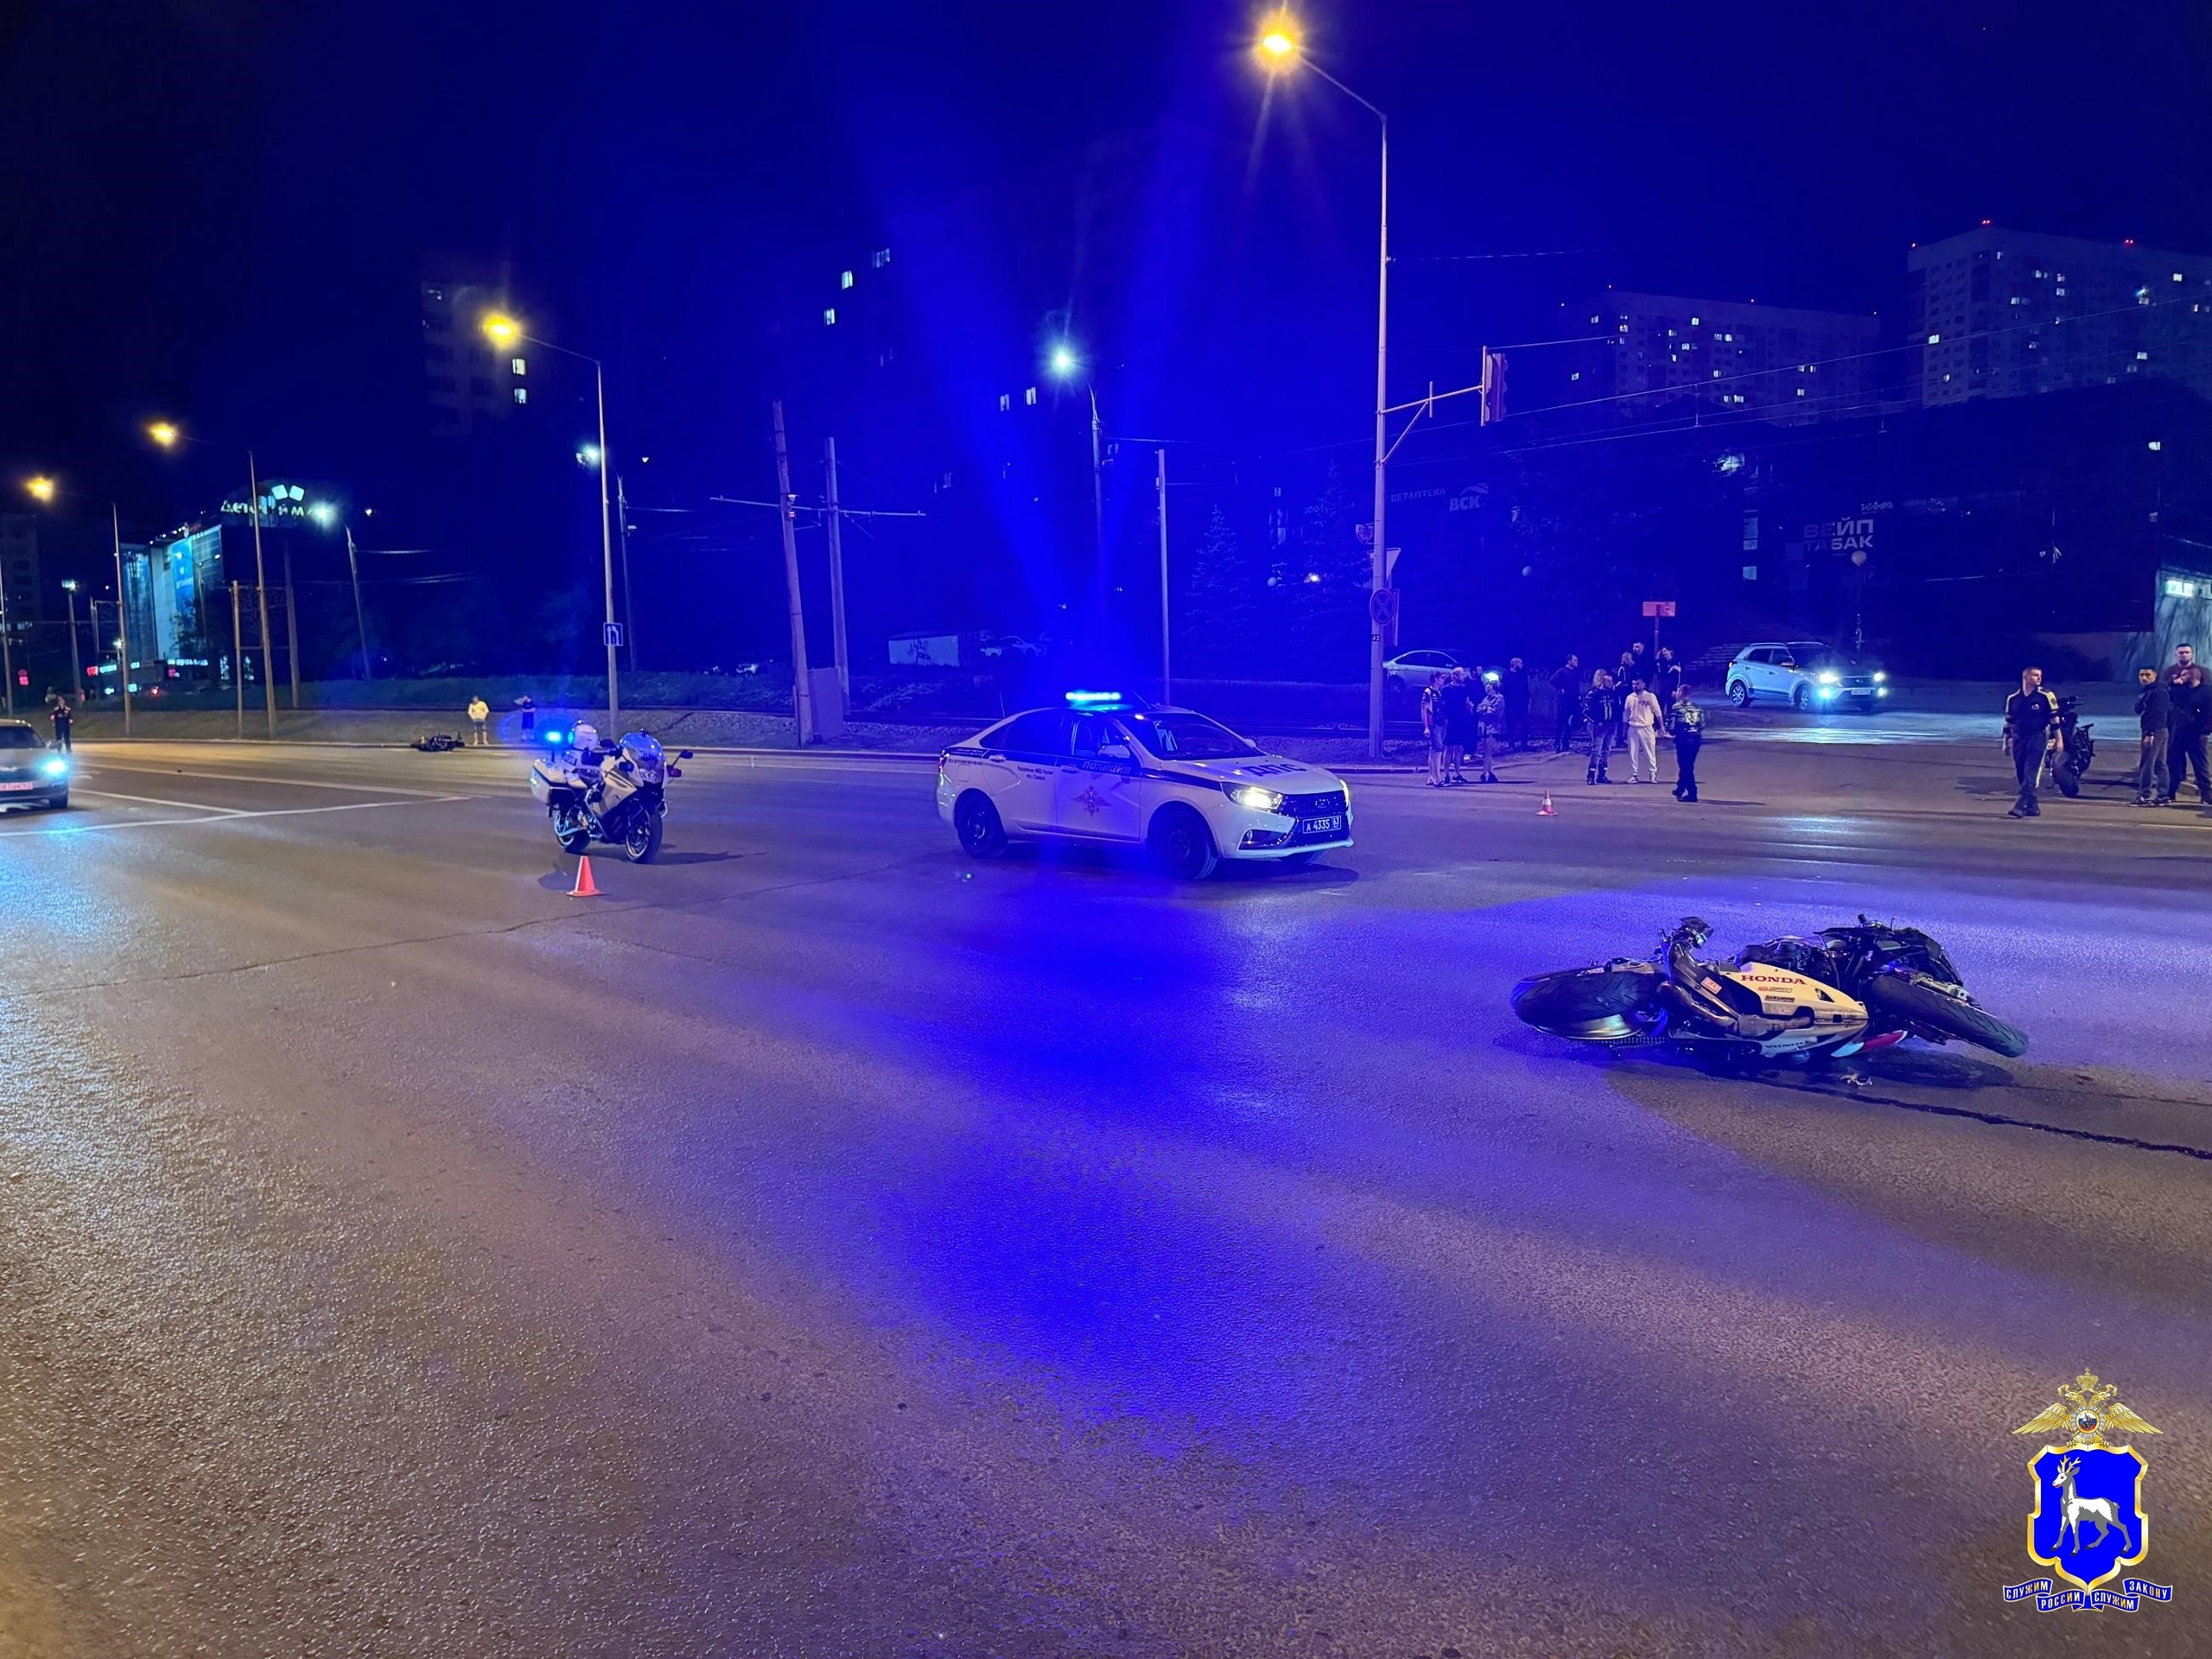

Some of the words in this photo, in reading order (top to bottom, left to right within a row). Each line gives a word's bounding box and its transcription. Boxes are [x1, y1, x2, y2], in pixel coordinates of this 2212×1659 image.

[1449, 495, 1481, 512] ВСК
[1803, 517, 1873, 537] ВЕЙП
[1802, 535, 1873, 551] ТАБАК
[1242, 764, 1306, 777] ДПС
[1741, 975, 1807, 985] HONDA
